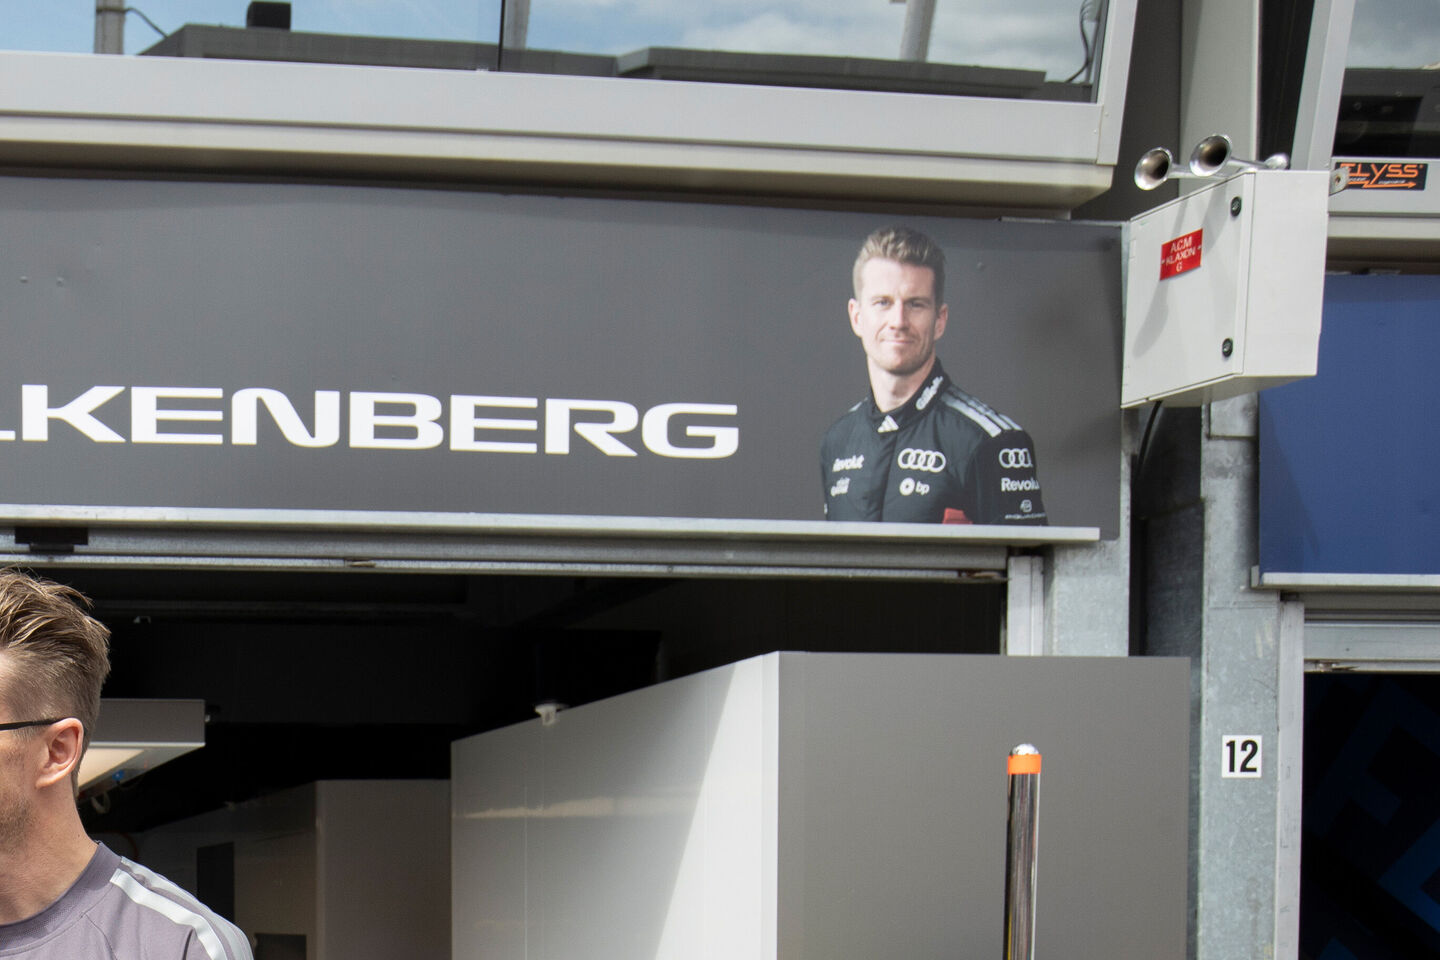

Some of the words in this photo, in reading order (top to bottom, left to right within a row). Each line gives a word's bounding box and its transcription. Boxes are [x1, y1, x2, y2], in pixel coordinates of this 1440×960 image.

[1170, 235, 1192, 253] ACM
[1001, 477, 1040, 492] Revolu
[1225, 739, 1259, 773] 12
